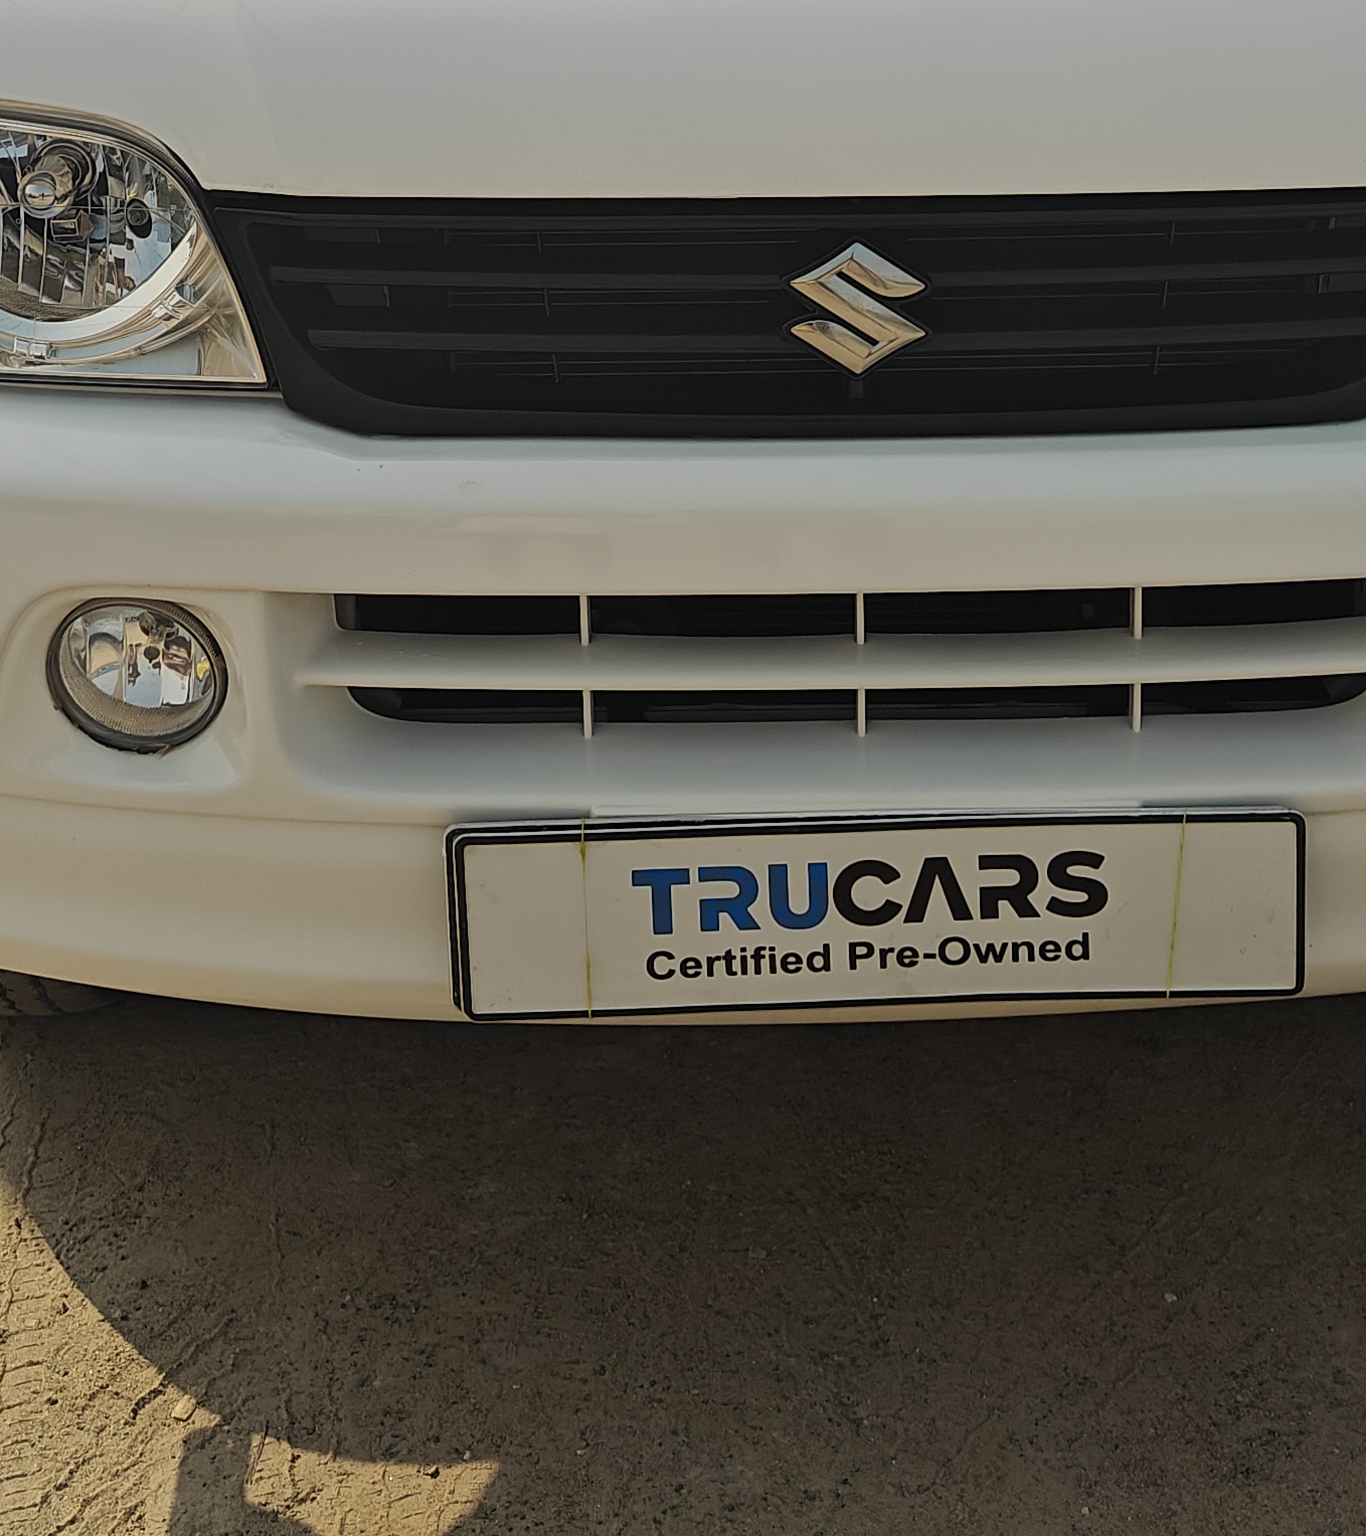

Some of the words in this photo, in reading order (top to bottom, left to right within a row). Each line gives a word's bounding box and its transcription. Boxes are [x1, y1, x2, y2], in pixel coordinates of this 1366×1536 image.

[631, 850, 1109, 936] TRUCARS
[645, 944, 832, 981] Certified
[847, 932, 1091, 971] Pre-Owned
